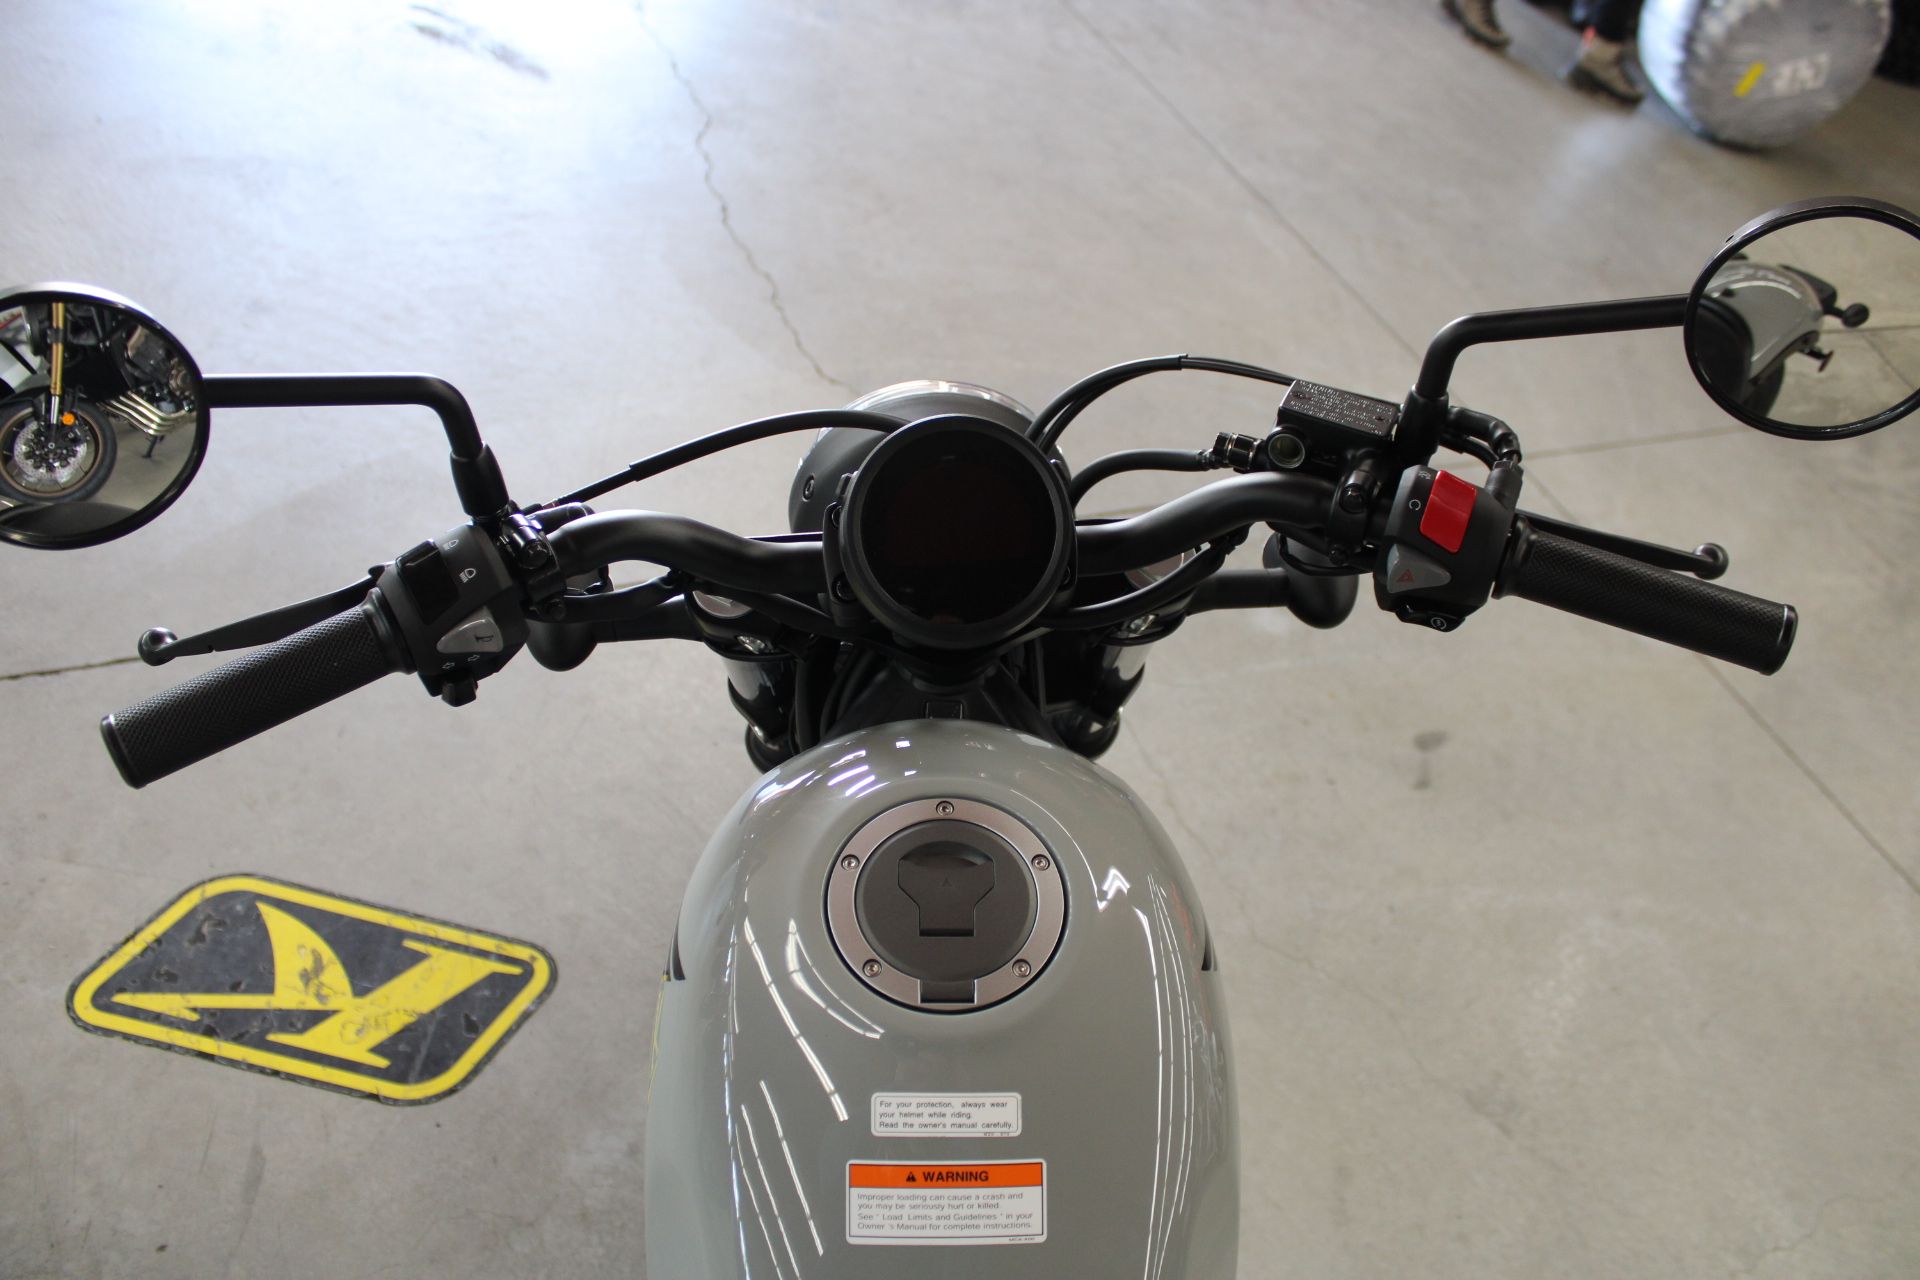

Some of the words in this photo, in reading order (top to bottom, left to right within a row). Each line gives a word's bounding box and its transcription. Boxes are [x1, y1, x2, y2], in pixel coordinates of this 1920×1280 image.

[916, 1101, 954, 1109] protection,
[961, 1102, 986, 1110] always
[922, 1171, 989, 1183] WARNING
[857, 1193, 894, 1202] Improper
[897, 1193, 927, 1202] loading
[1007, 1192, 1024, 1200] and
[857, 1203, 873, 1211] you
[875, 1203, 893, 1211] may
[909, 1203, 945, 1211] seriously
[857, 1213, 874, 1221] See
[882, 1213, 903, 1221] Load
[907, 1213, 933, 1221] Limits
[953, 1213, 997, 1221] Guidelines
[943, 1223, 981, 1231] complete
